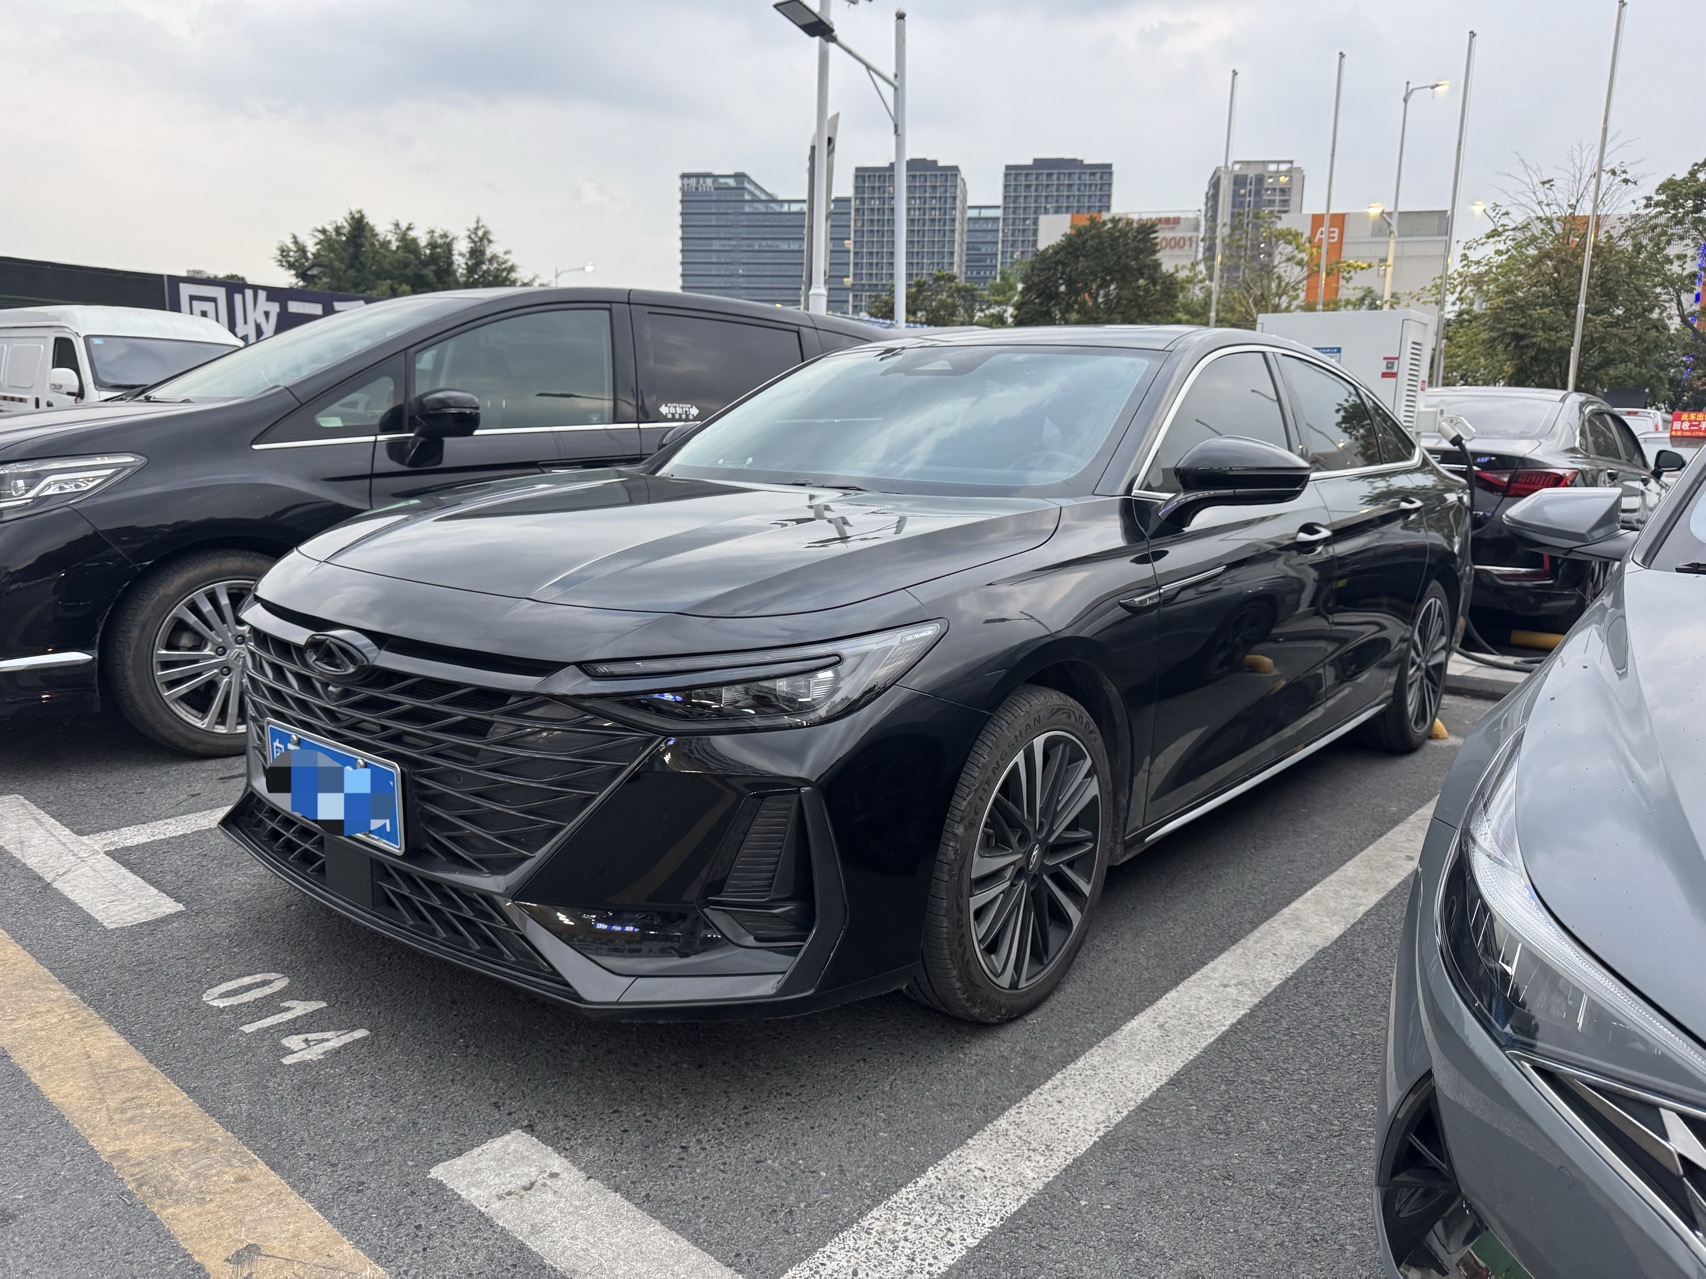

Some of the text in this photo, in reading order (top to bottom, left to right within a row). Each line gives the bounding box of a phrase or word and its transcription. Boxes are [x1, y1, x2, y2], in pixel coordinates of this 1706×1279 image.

[1314, 226, 1339, 243] A3
[1682, 412, 1706, 421] 此车出
[202, 972, 371, 1065] 014
